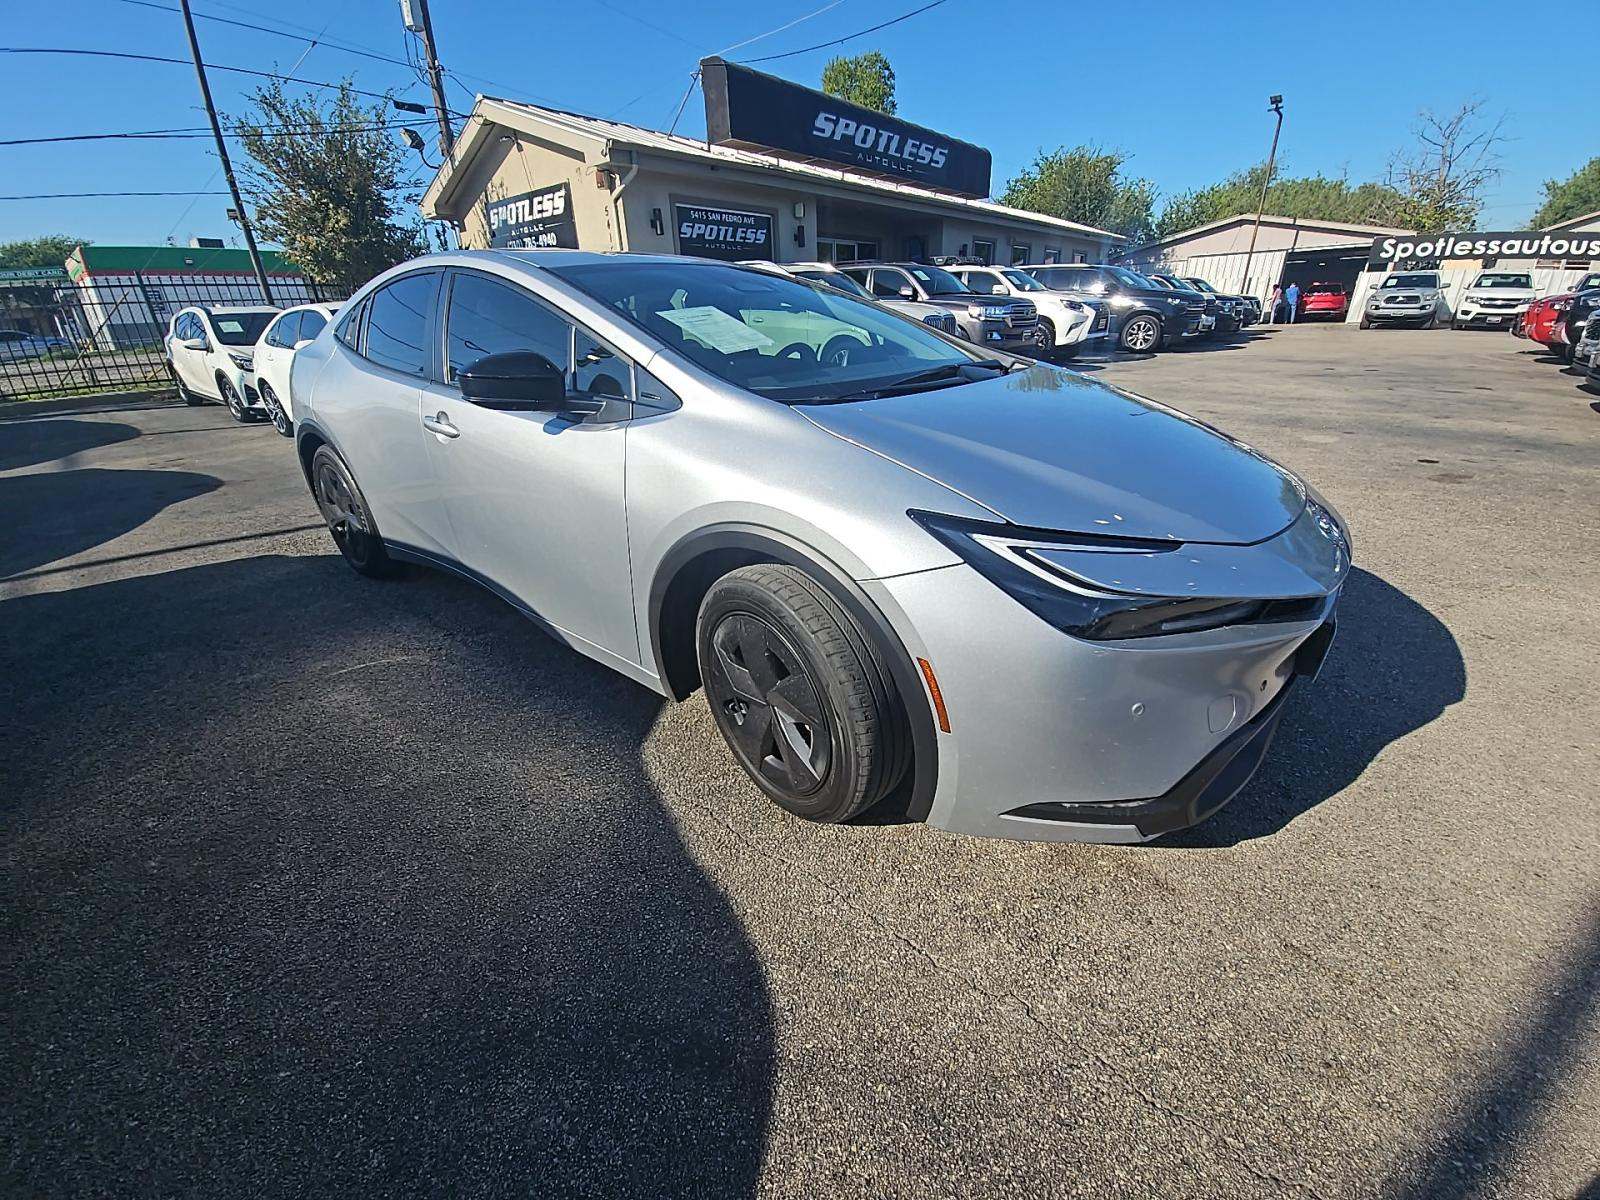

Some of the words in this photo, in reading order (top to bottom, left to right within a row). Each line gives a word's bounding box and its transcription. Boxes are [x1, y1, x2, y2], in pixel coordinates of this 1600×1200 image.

[813, 112, 948, 168] SPOTLESS
[490, 191, 566, 229] SPOTLESS
[690, 210, 706, 219] 5415
[708, 212, 720, 221] SAN
[722, 213, 742, 224] PEDRO
[743, 216, 755, 225] AVE
[680, 222, 766, 244] SPOTLESS
